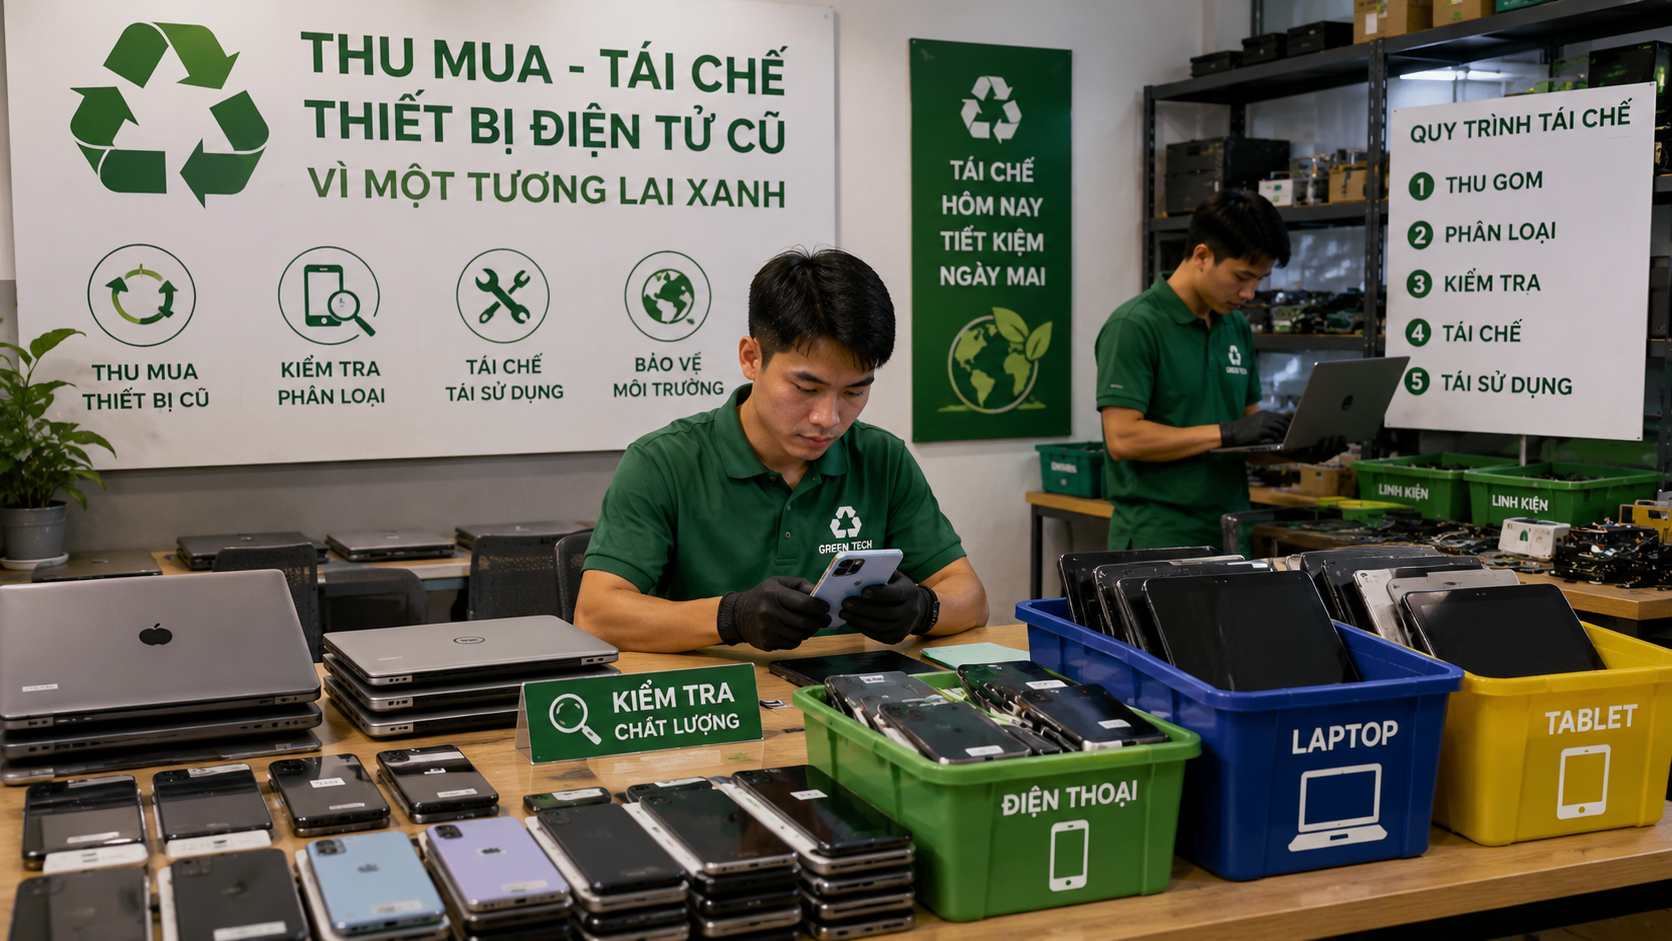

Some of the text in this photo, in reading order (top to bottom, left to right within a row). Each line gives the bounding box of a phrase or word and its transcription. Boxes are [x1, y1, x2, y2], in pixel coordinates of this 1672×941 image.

[300, 31, 788, 96] THU MUA - TÁI CHẾ
[304, 89, 786, 158] THIẾT BỊ ĐIỆN TỬ CŨ
[1410, 98, 1632, 144] QUY TRÌNH TÁI CHẾ
[949, 155, 1035, 183] TÁI CHẾ
[307, 160, 785, 209] VÌ MỘT TƯƠNG LAI XANH
[1416, 171, 1543, 196] 1 THU GOM
[942, 190, 1044, 217] HÔM NAY
[940, 224, 1044, 257] TIẾT KIỆM
[1414, 220, 1556, 245] 2 PHÂN LOẠI
[940, 261, 1046, 286] NGÀY MAI
[1413, 274, 1426, 294] 3
[1444, 267, 1493, 293] KIỂM
[1411, 318, 1523, 343] 4 TÁI CHẾ
[91, 363, 199, 381] THU MUA
[281, 354, 381, 378] KIỂM TRA
[466, 352, 543, 375] TÁI CHẾ
[278, 384, 385, 407] PHÂN LOẠI
[445, 381, 564, 404] TÁI SỬ DỤNG
[613, 378, 724, 398] MÔI TRƯỜNG
[1411, 370, 1573, 399] 5 TÁI SỬ DỤNG
[82, 387, 209, 412] THIẾT BỊ CŨ
[1378, 483, 1403, 498] LINH
[1492, 494, 1549, 514] LINH KIỆN
[818, 540, 873, 554] GREEN TECH
[612, 679, 735, 713] KIỂM TRA
[614, 713, 740, 740] CHẤT LƯỢNG
[1544, 703, 1639, 735] TABLET
[1291, 719, 1399, 755] LAPTOP
[1001, 779, 1138, 818] ĐIỆN THOẠI
